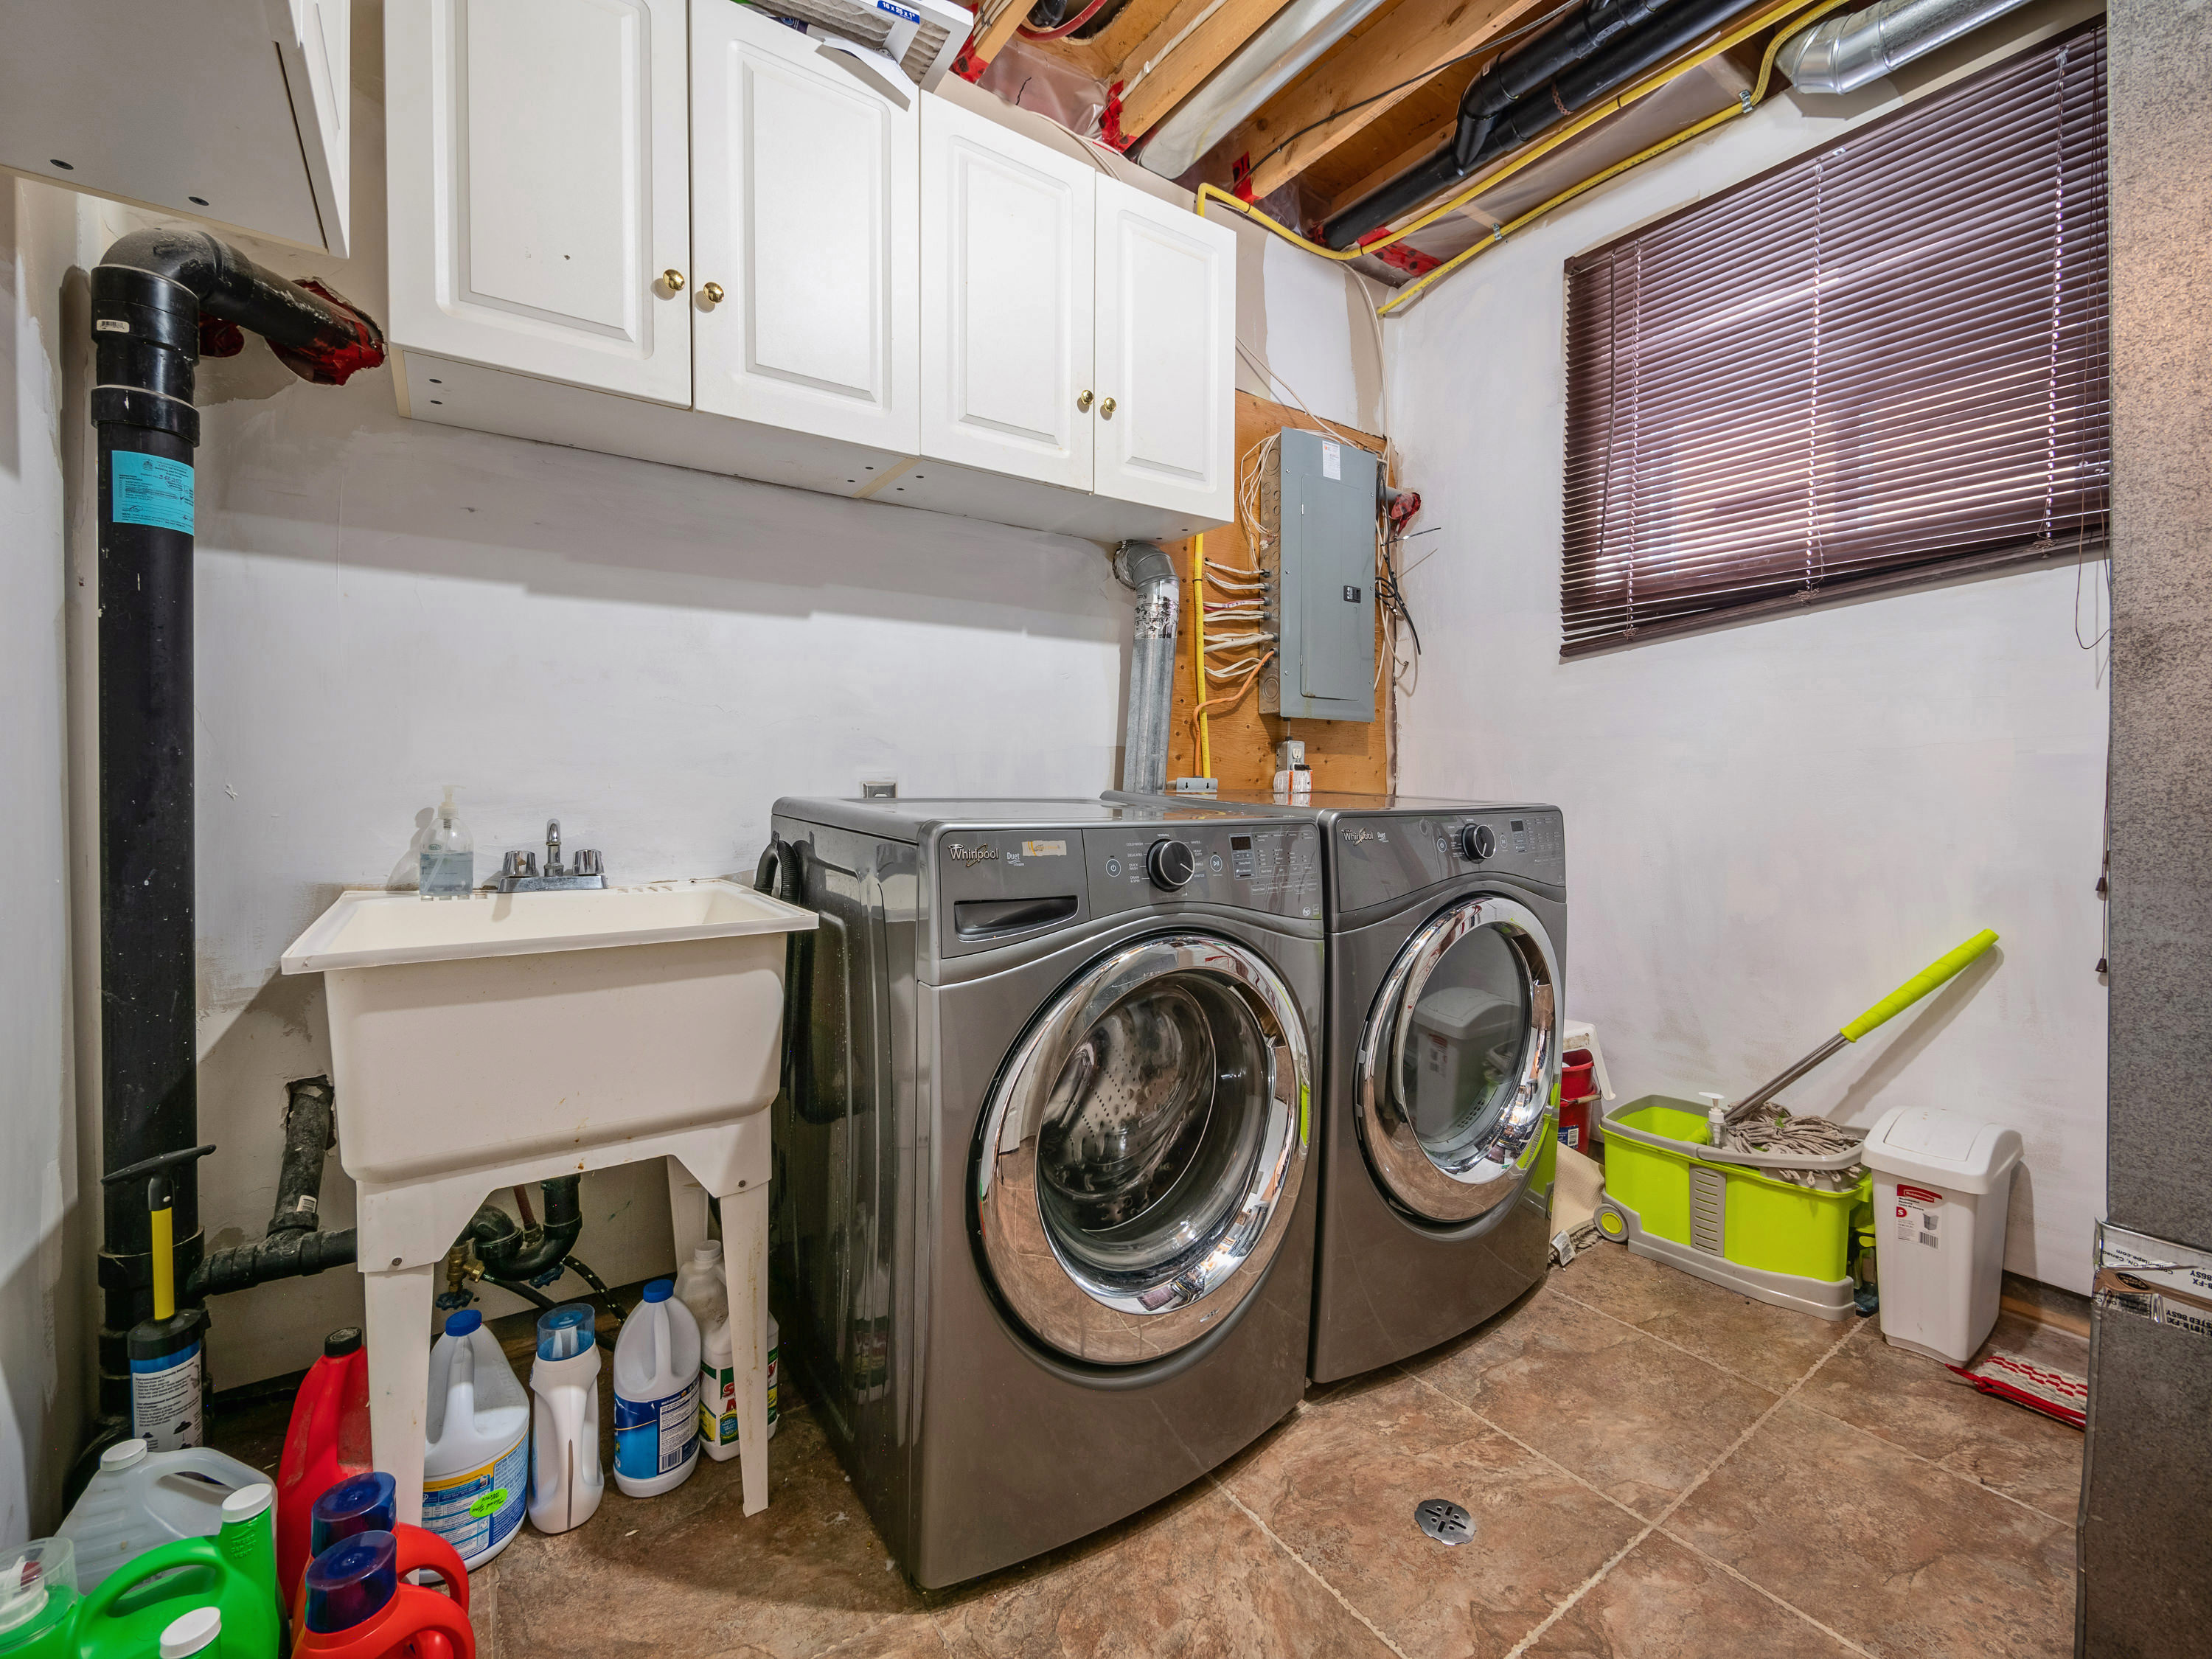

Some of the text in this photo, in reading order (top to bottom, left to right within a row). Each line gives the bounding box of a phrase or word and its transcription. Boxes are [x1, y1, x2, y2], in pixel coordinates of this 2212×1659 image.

[1343, 831, 1374, 843] Whirlpool
[950, 847, 999, 862] Whirlpool
[1006, 852, 1020, 860] Duet
[2166, 1310, 2188, 1321] 86SY
[472, 1497, 504, 1512] Thank You
